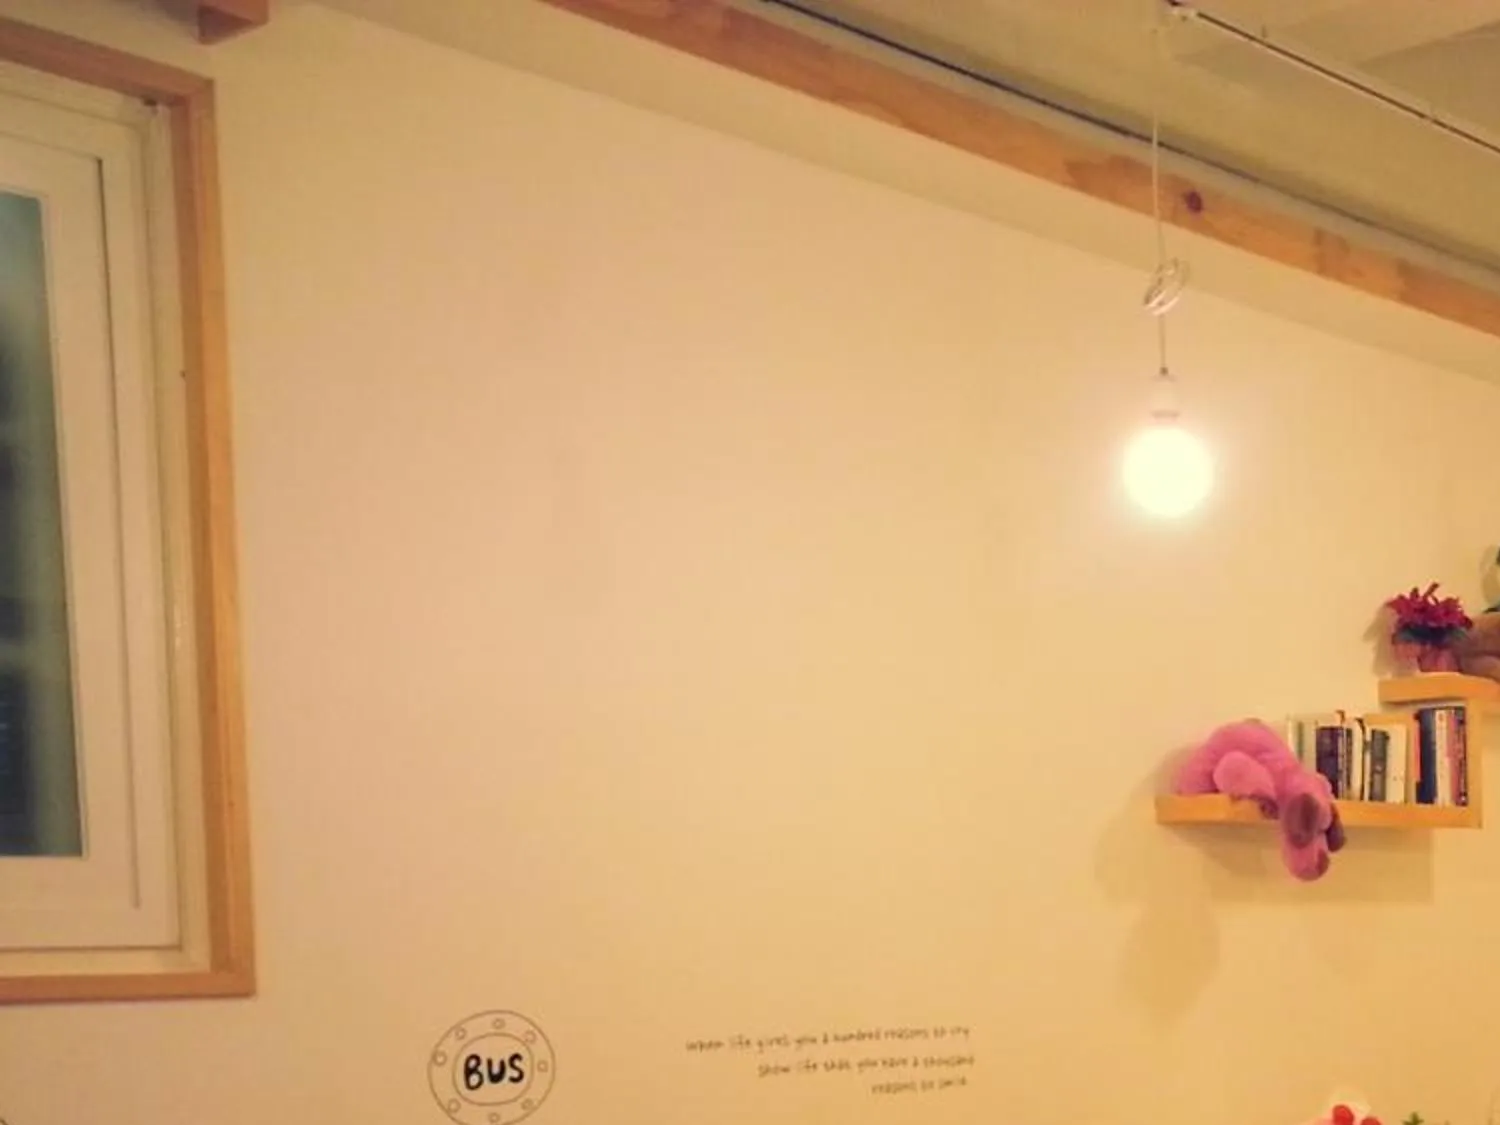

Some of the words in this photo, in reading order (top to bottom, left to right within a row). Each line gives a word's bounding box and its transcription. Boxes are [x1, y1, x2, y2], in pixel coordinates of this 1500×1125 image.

[795, 1035, 817, 1052] you
[833, 1027, 881, 1044] hundred
[884, 1026, 929, 1041] reasons
[933, 1024, 947, 1040] to
[464, 1053, 524, 1090] BUS
[856, 1058, 878, 1073] you
[881, 1055, 908, 1069] have
[923, 1053, 975, 1068] thousand
